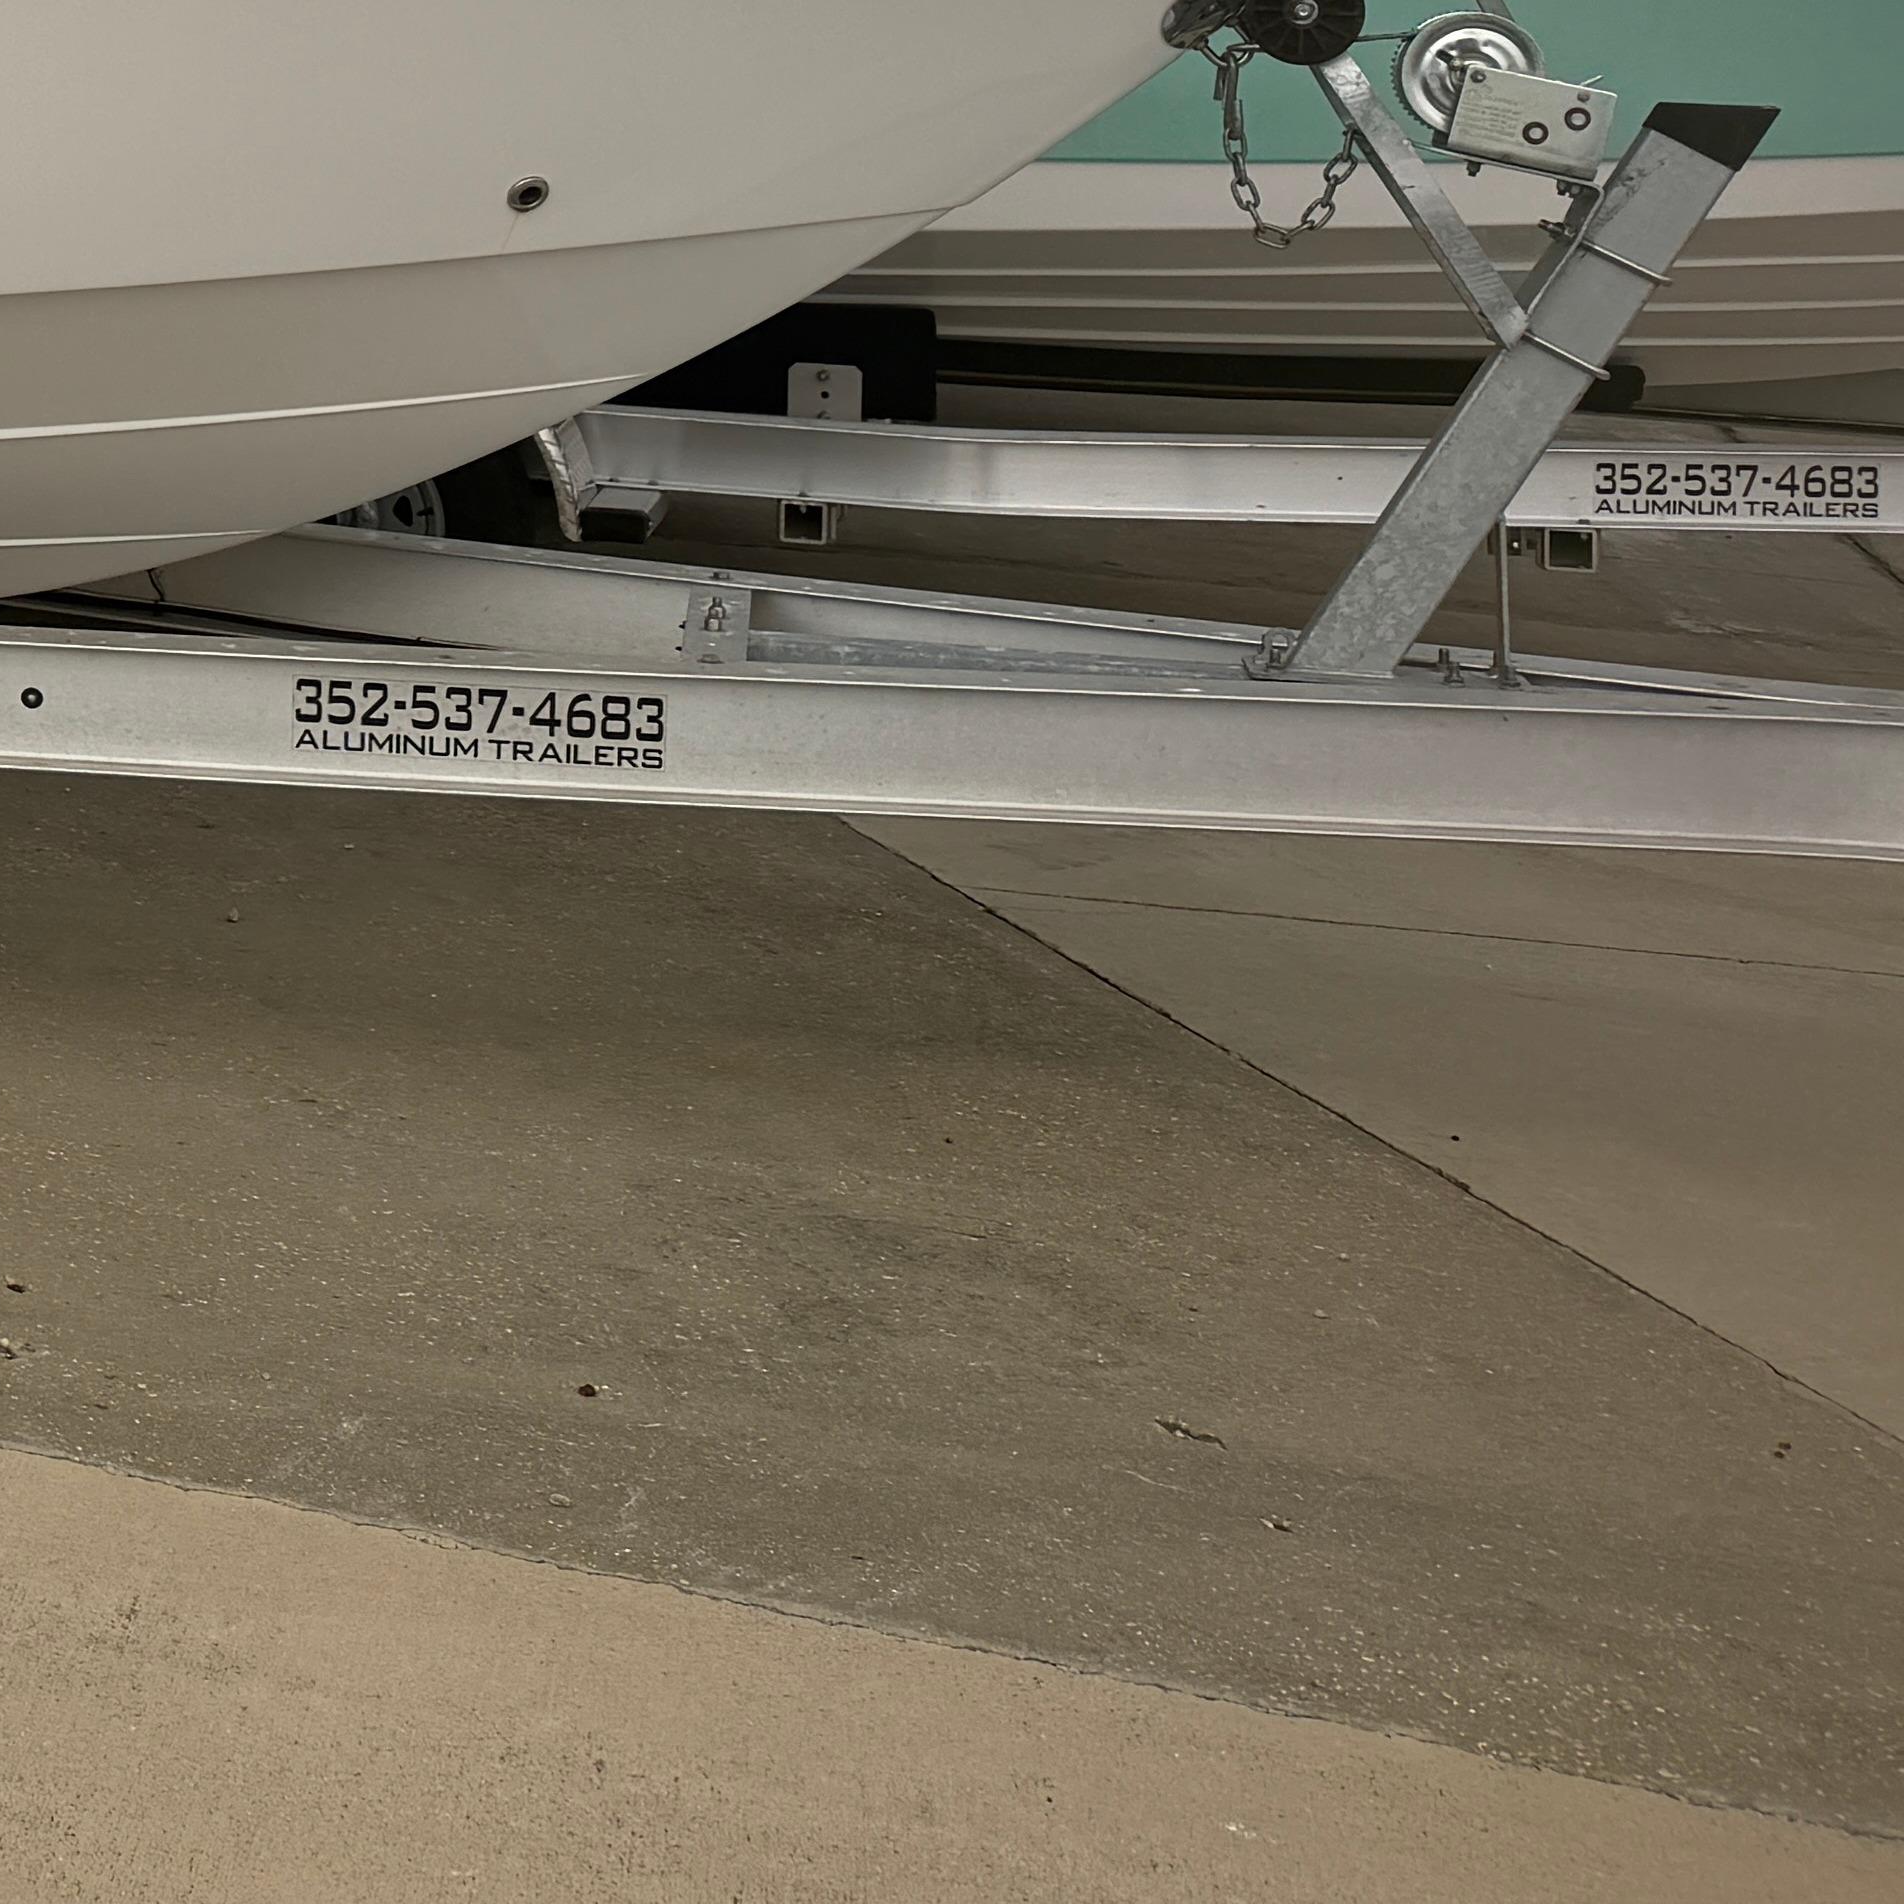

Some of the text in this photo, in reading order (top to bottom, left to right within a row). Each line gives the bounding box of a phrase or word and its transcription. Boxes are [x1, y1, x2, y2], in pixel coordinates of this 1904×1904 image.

[1595, 462, 1879, 498] 352-537-4683
[1595, 499, 1879, 518] ALUMINUM TRAILERS
[295, 678, 665, 742] 352-537-4683
[295, 728, 664, 769] ALUMINUM TRAILERS
